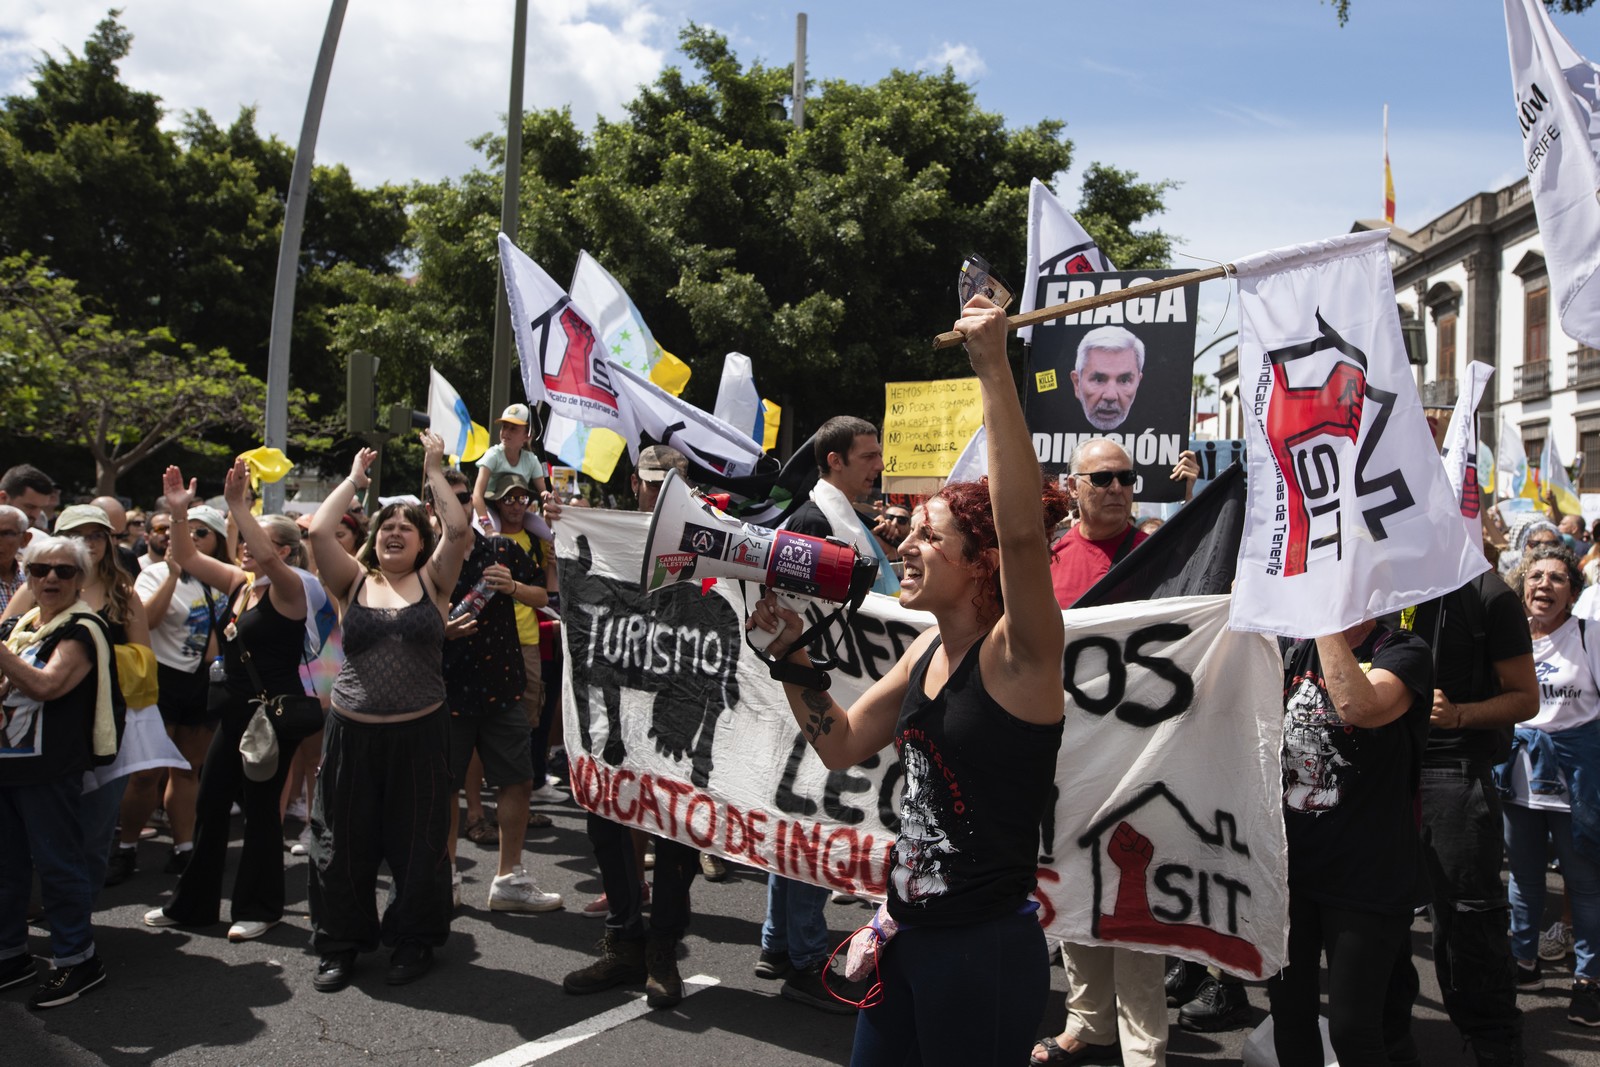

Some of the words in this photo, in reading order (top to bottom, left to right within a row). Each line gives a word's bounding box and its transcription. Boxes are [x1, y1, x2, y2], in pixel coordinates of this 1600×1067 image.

[1043, 277, 1188, 326] FRAGA
[890, 386, 922, 400] HEMOS
[927, 383, 958, 395] PASADO
[962, 382, 974, 391] DE
[891, 403, 905, 415] NO
[909, 401, 936, 413] PODER
[888, 432, 901, 444] NO
[913, 442, 958, 453] ALQUILER
[1296, 443, 1342, 562] SIT
[1275, 504, 1287, 521] de
[745, 554, 760, 562] SIT
[1265, 524, 1287, 577] Tenerife
[776, 566, 810, 579] FEMINISTA
[778, 561, 811, 573] CANARIAS
[1542, 683, 1582, 699] Unión
[724, 804, 769, 855] DE
[1153, 863, 1251, 934] SIT
